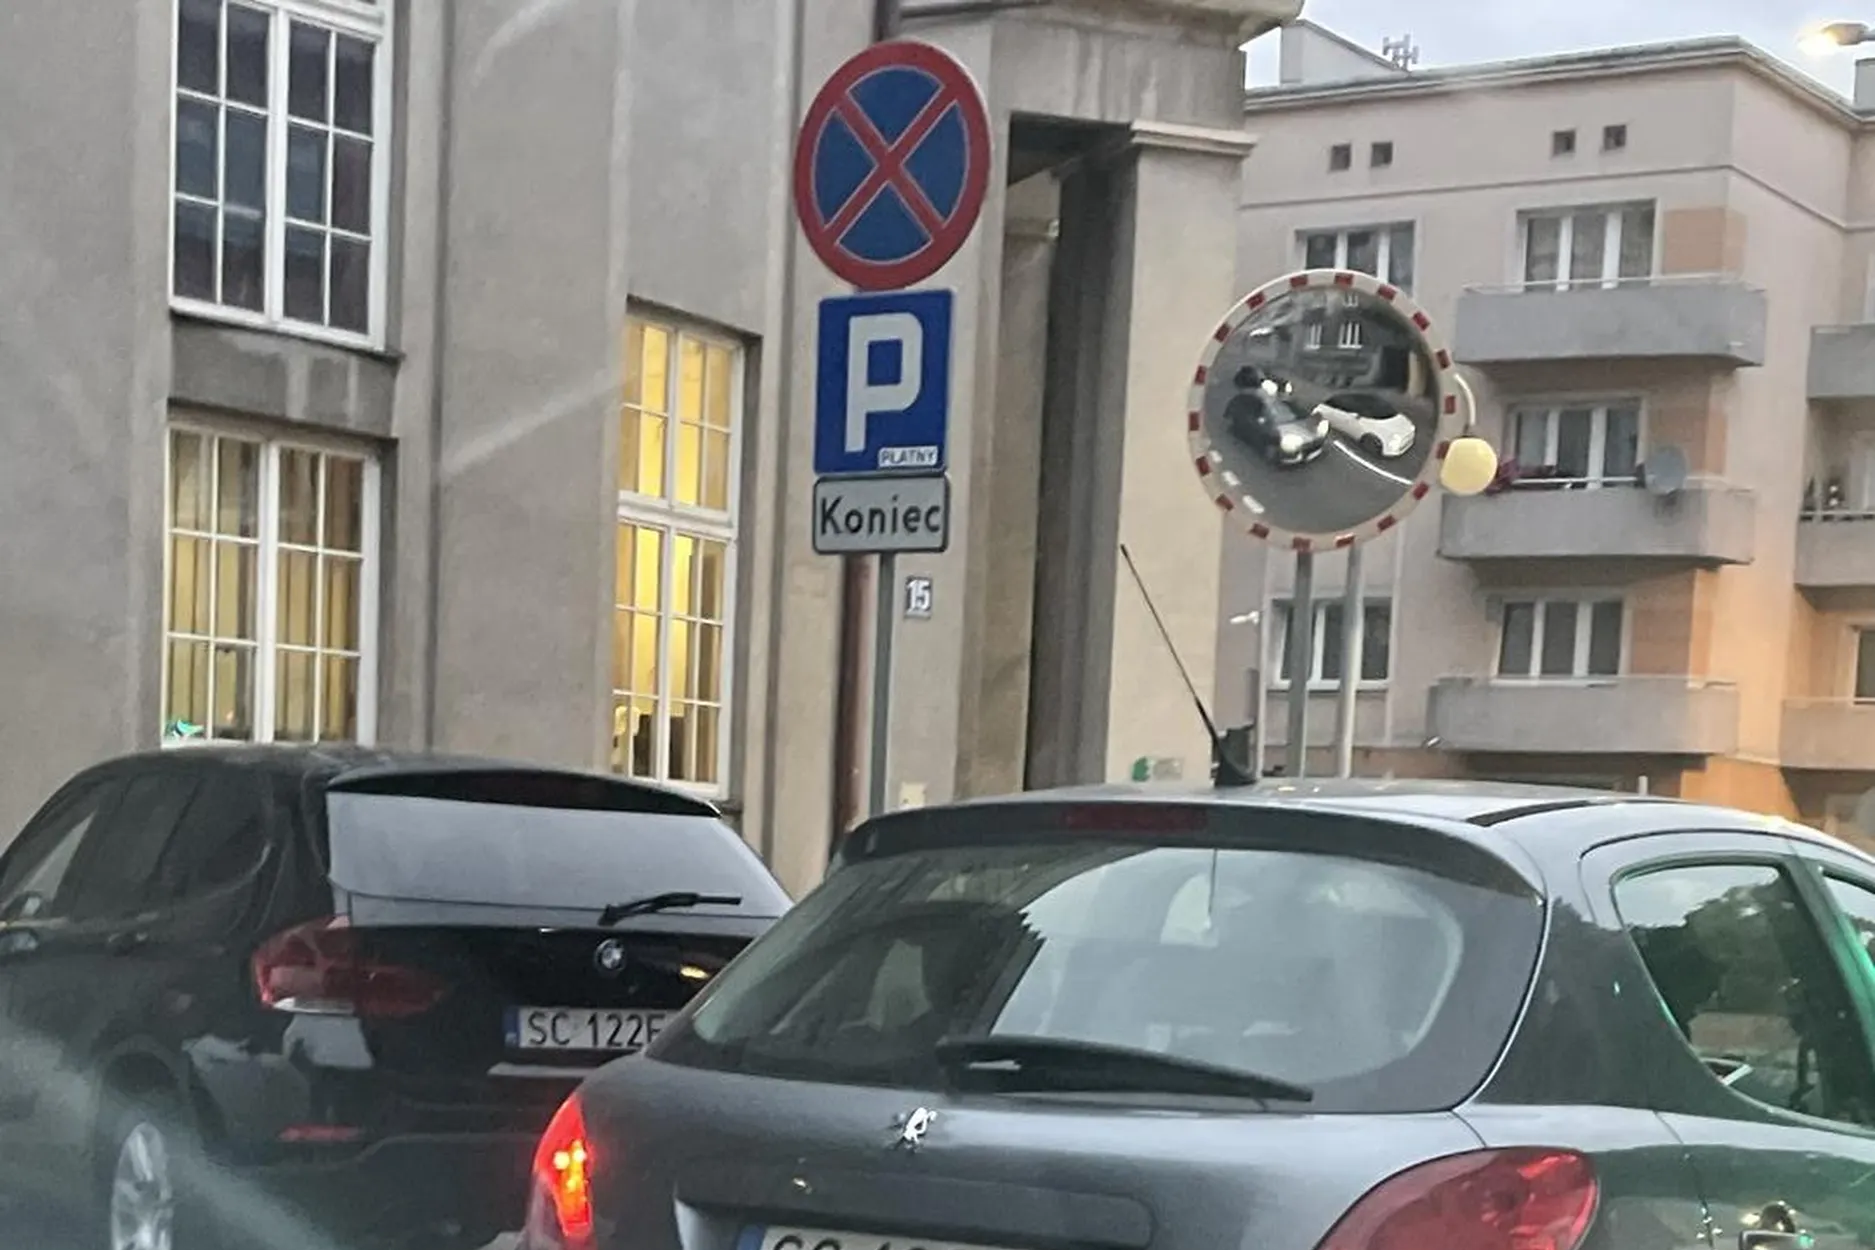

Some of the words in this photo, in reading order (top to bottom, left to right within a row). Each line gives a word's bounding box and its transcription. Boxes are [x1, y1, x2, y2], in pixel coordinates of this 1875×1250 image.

[845, 312, 923, 452] P
[820, 494, 941, 536] Koniec
[906, 579, 932, 614] 15
[528, 1011, 569, 1045] SC
